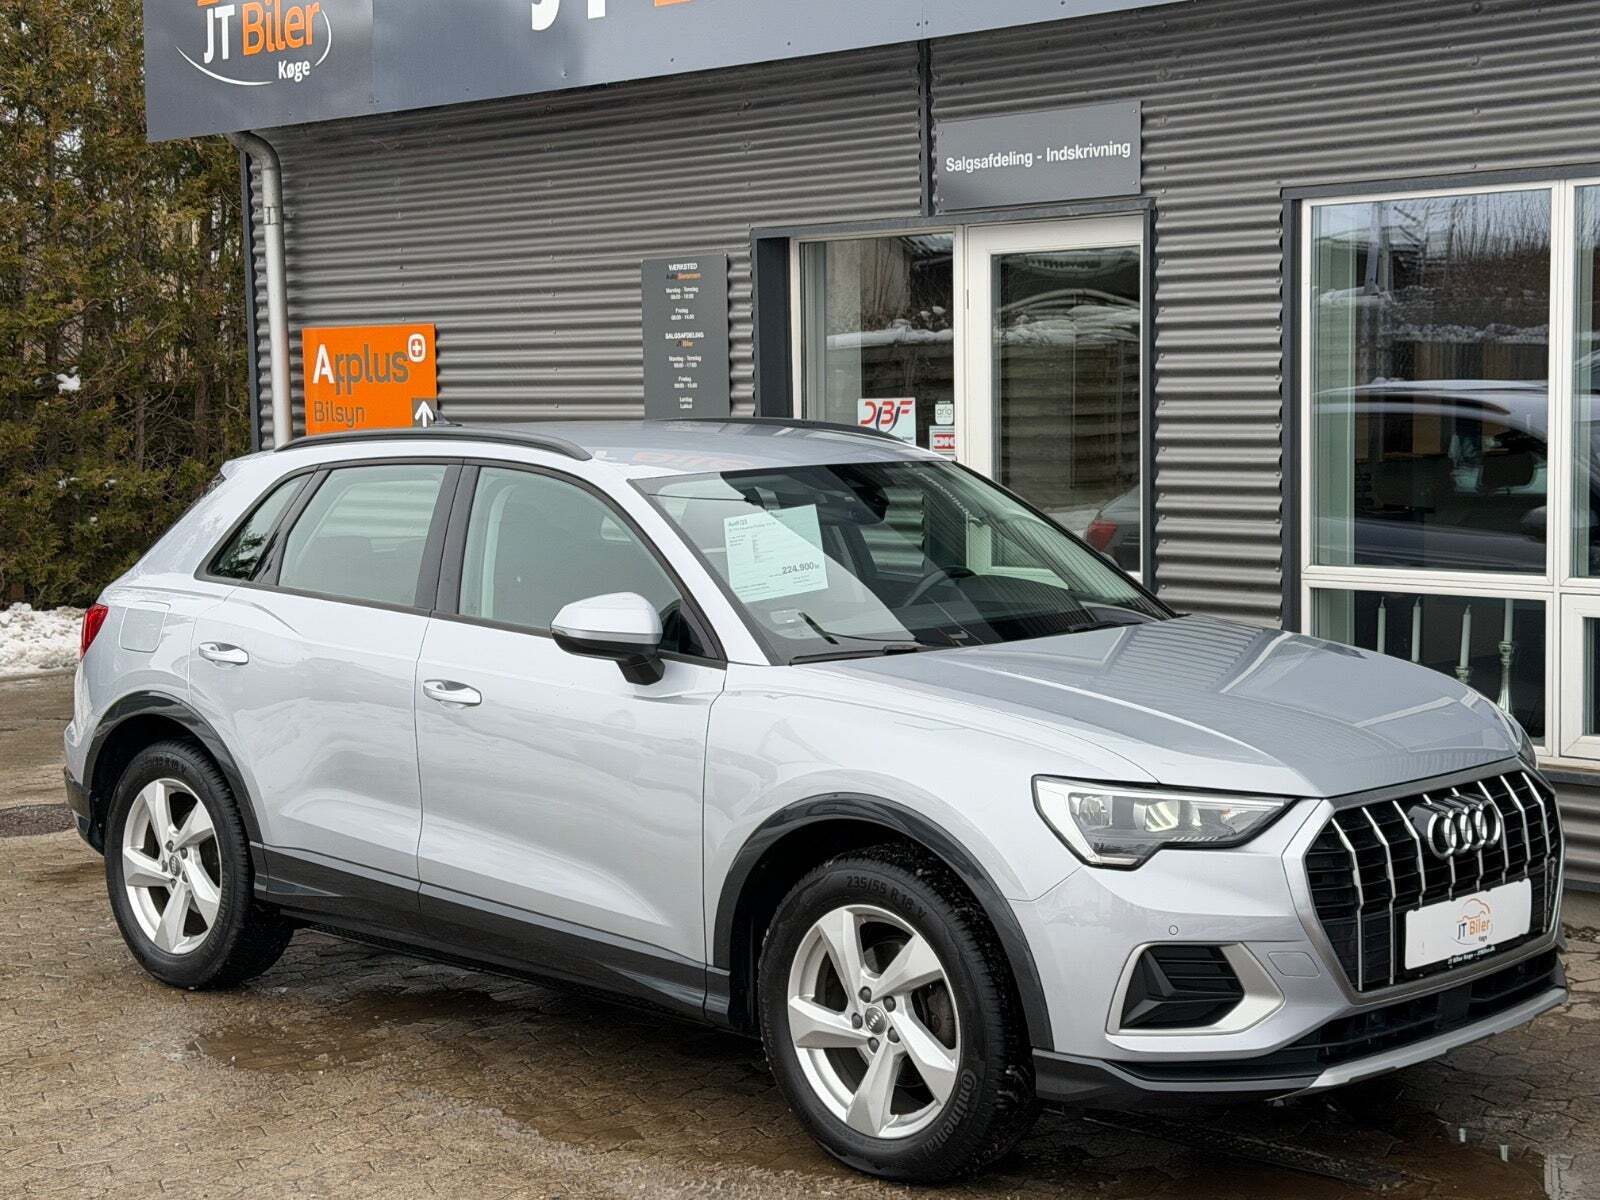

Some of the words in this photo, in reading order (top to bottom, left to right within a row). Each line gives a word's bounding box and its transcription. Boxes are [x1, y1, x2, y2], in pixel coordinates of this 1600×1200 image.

[203, 4, 235, 64] JT
[241, 0, 320, 56] Biler
[278, 59, 311, 82] Køge
[945, 151, 1033, 174] Salgsafdeling
[1046, 140, 1131, 162] Indskrivning
[313, 400, 365, 428] Bilsyn
[782, 561, 815, 575] 224.900
[1457, 922, 1467, 940] JT
[1469, 918, 1490, 936] Biler
